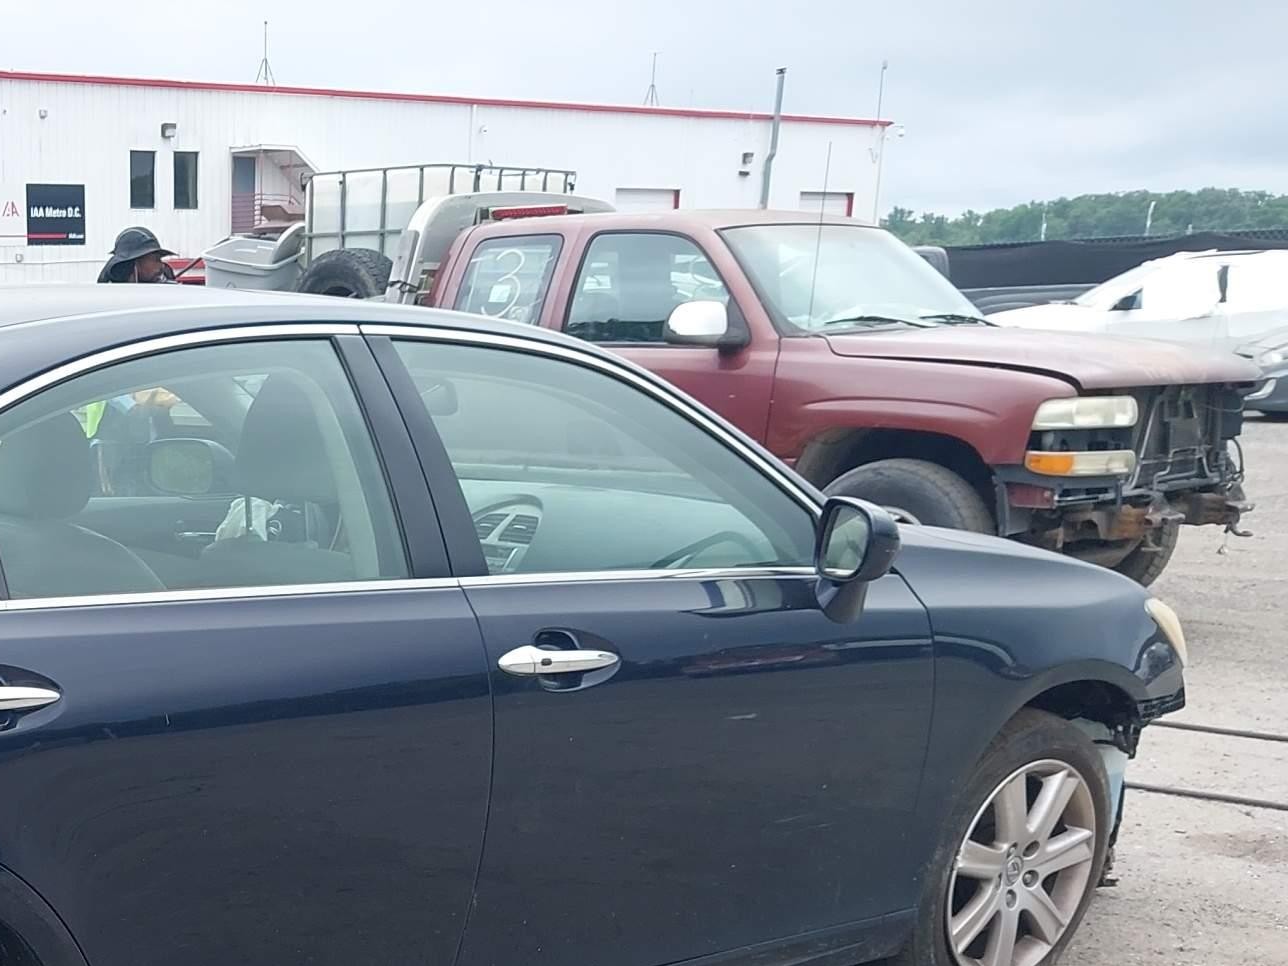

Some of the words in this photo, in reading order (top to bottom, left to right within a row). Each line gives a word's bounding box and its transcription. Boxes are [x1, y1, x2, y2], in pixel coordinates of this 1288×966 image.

[30, 205, 45, 218] IAA
[45, 205, 67, 218] Metro
[67, 205, 82, 218] D.C.
